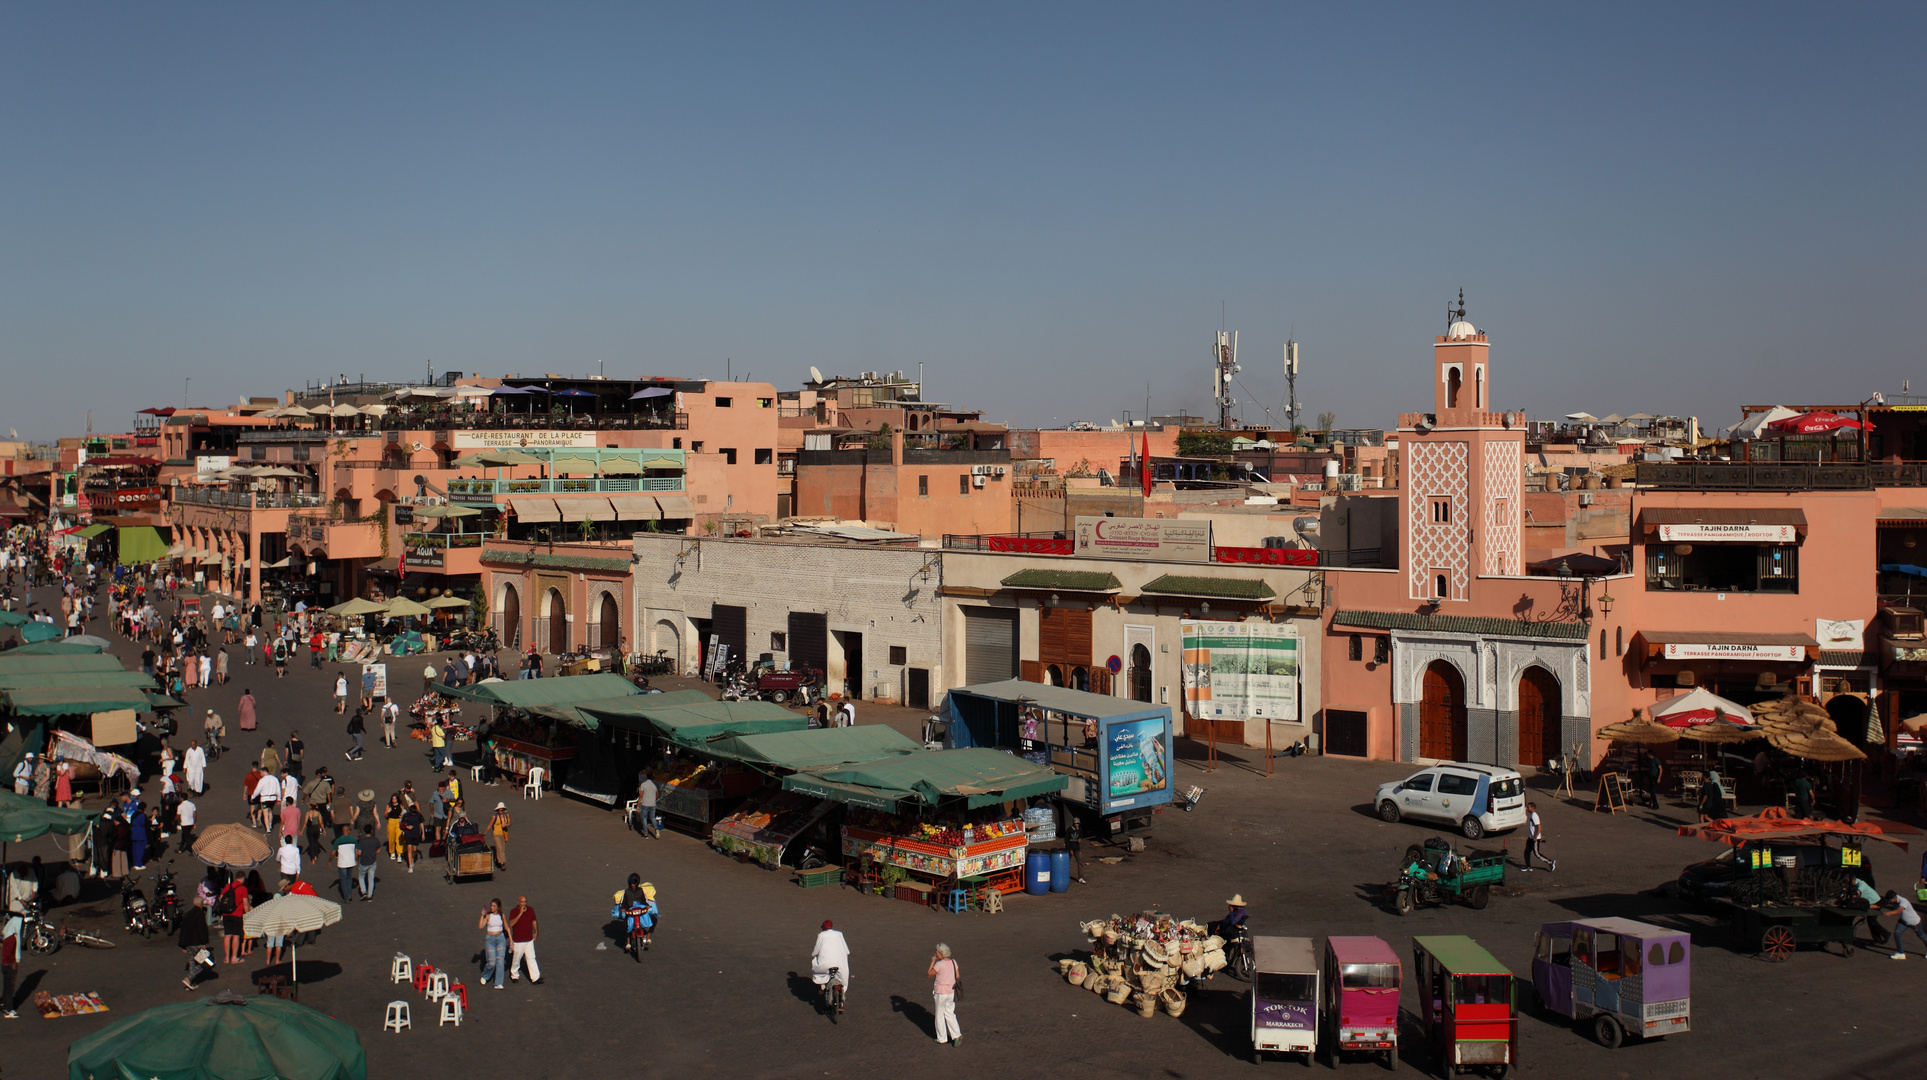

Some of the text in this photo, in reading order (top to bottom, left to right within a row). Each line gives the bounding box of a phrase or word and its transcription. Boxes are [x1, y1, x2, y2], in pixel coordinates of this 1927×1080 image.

[1128, 523, 1144, 531] الأحمر
[416, 547, 434, 557] AQUA
[1265, 1020, 1304, 1028] MARRAKECH
